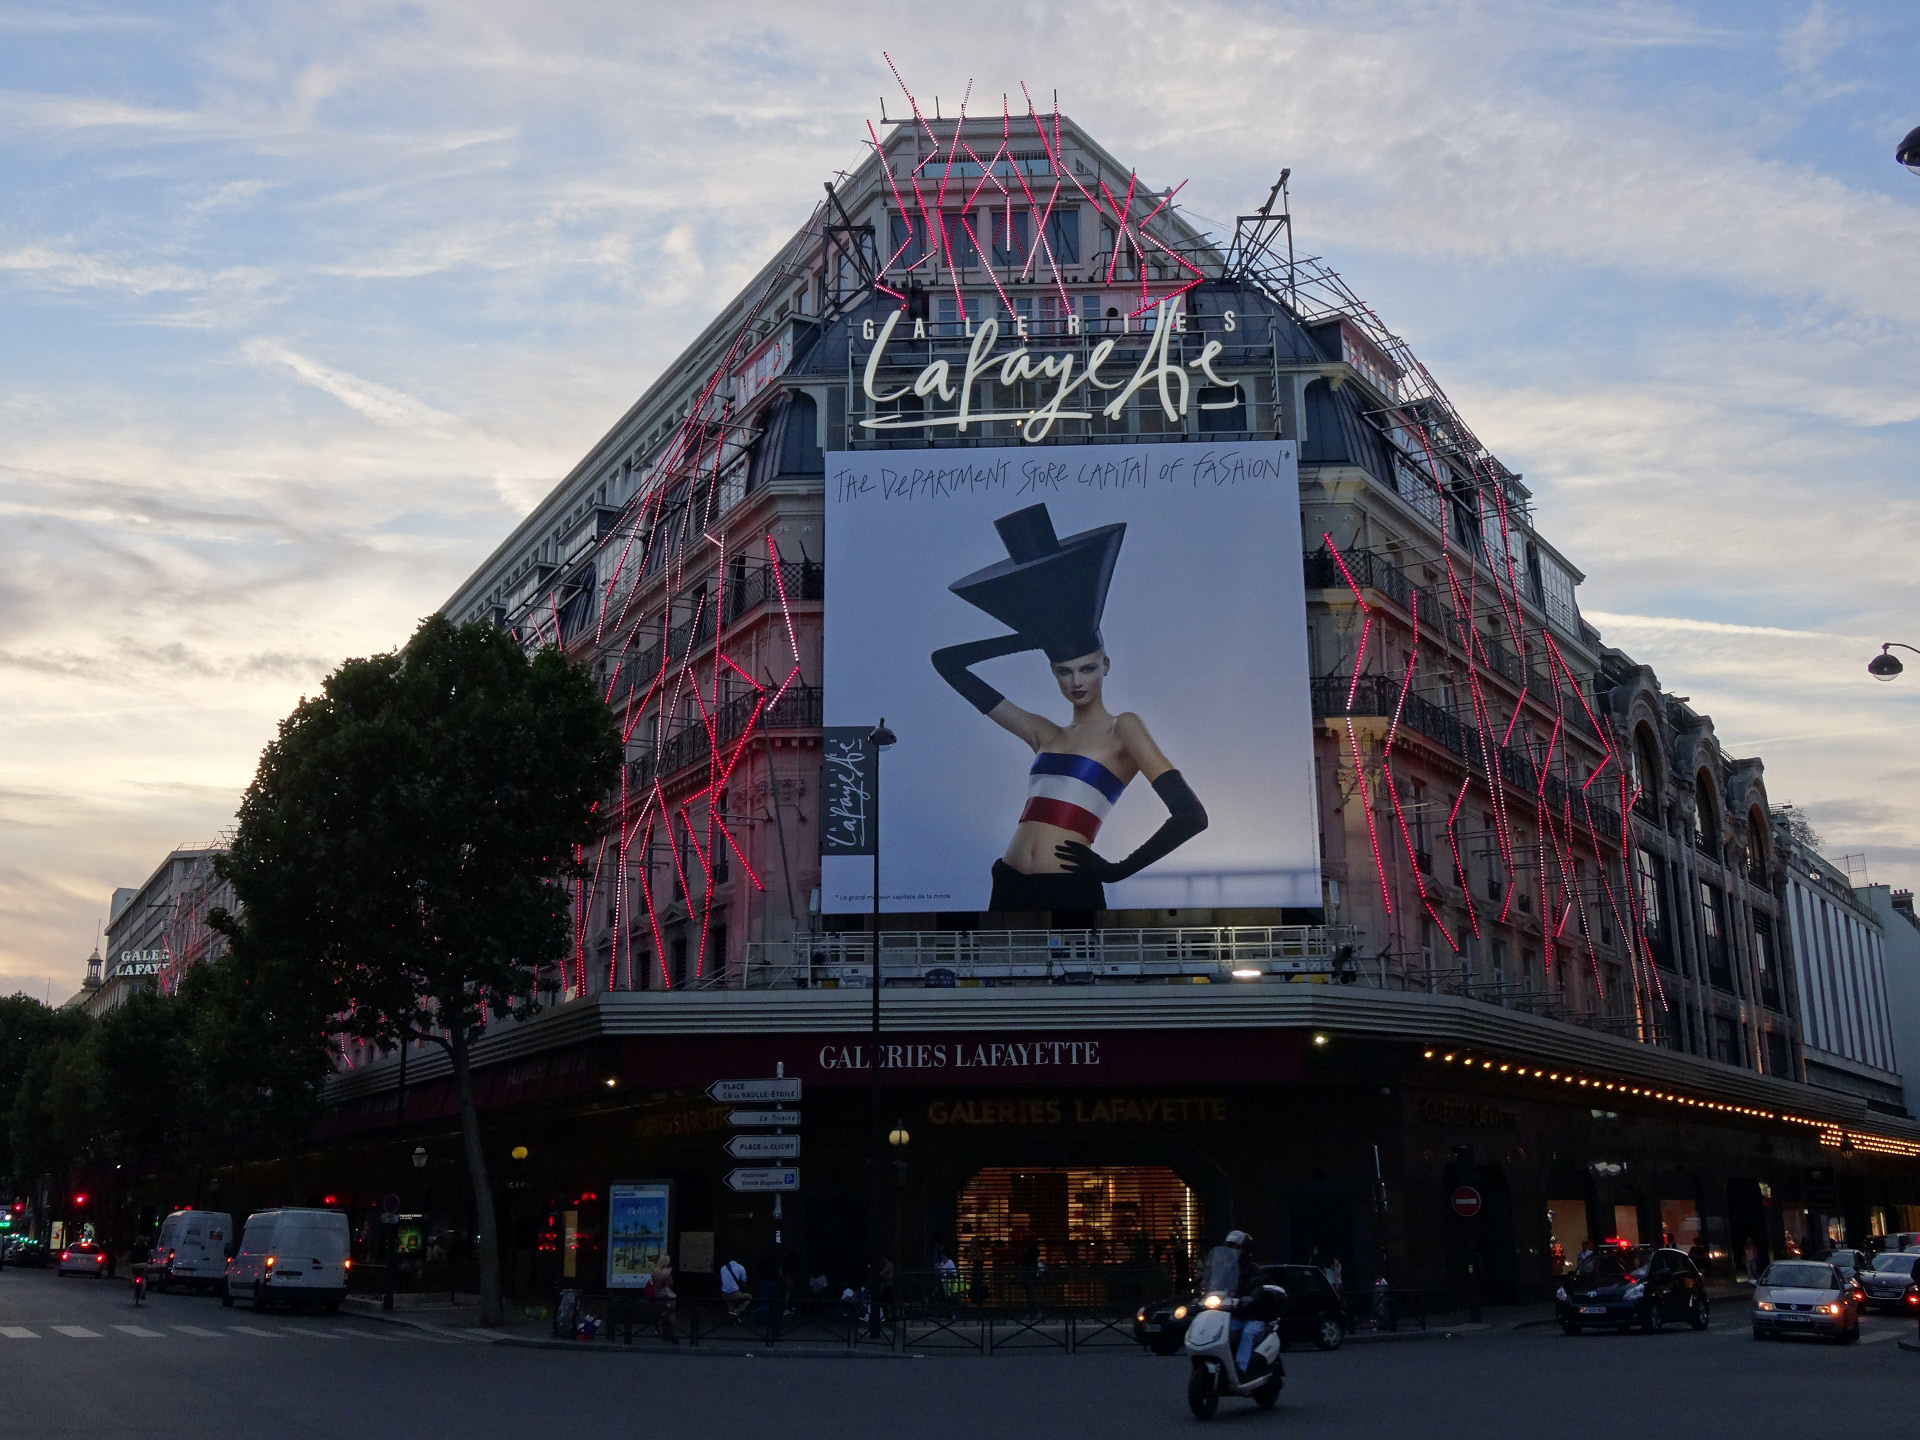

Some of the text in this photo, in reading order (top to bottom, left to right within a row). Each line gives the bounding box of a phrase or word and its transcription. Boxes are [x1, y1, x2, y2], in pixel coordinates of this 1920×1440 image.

[863, 310, 1236, 341] GALERIES
[859, 295, 1240, 443] Lafayette
[825, 739, 870, 847] Lafayette
[848, 894, 866, 902] grand
[892, 893, 915, 902] capitale
[954, 1041, 1100, 1067] LAFAYETTE
[928, 1096, 1227, 1125] GALERIES LAFAYETTE
